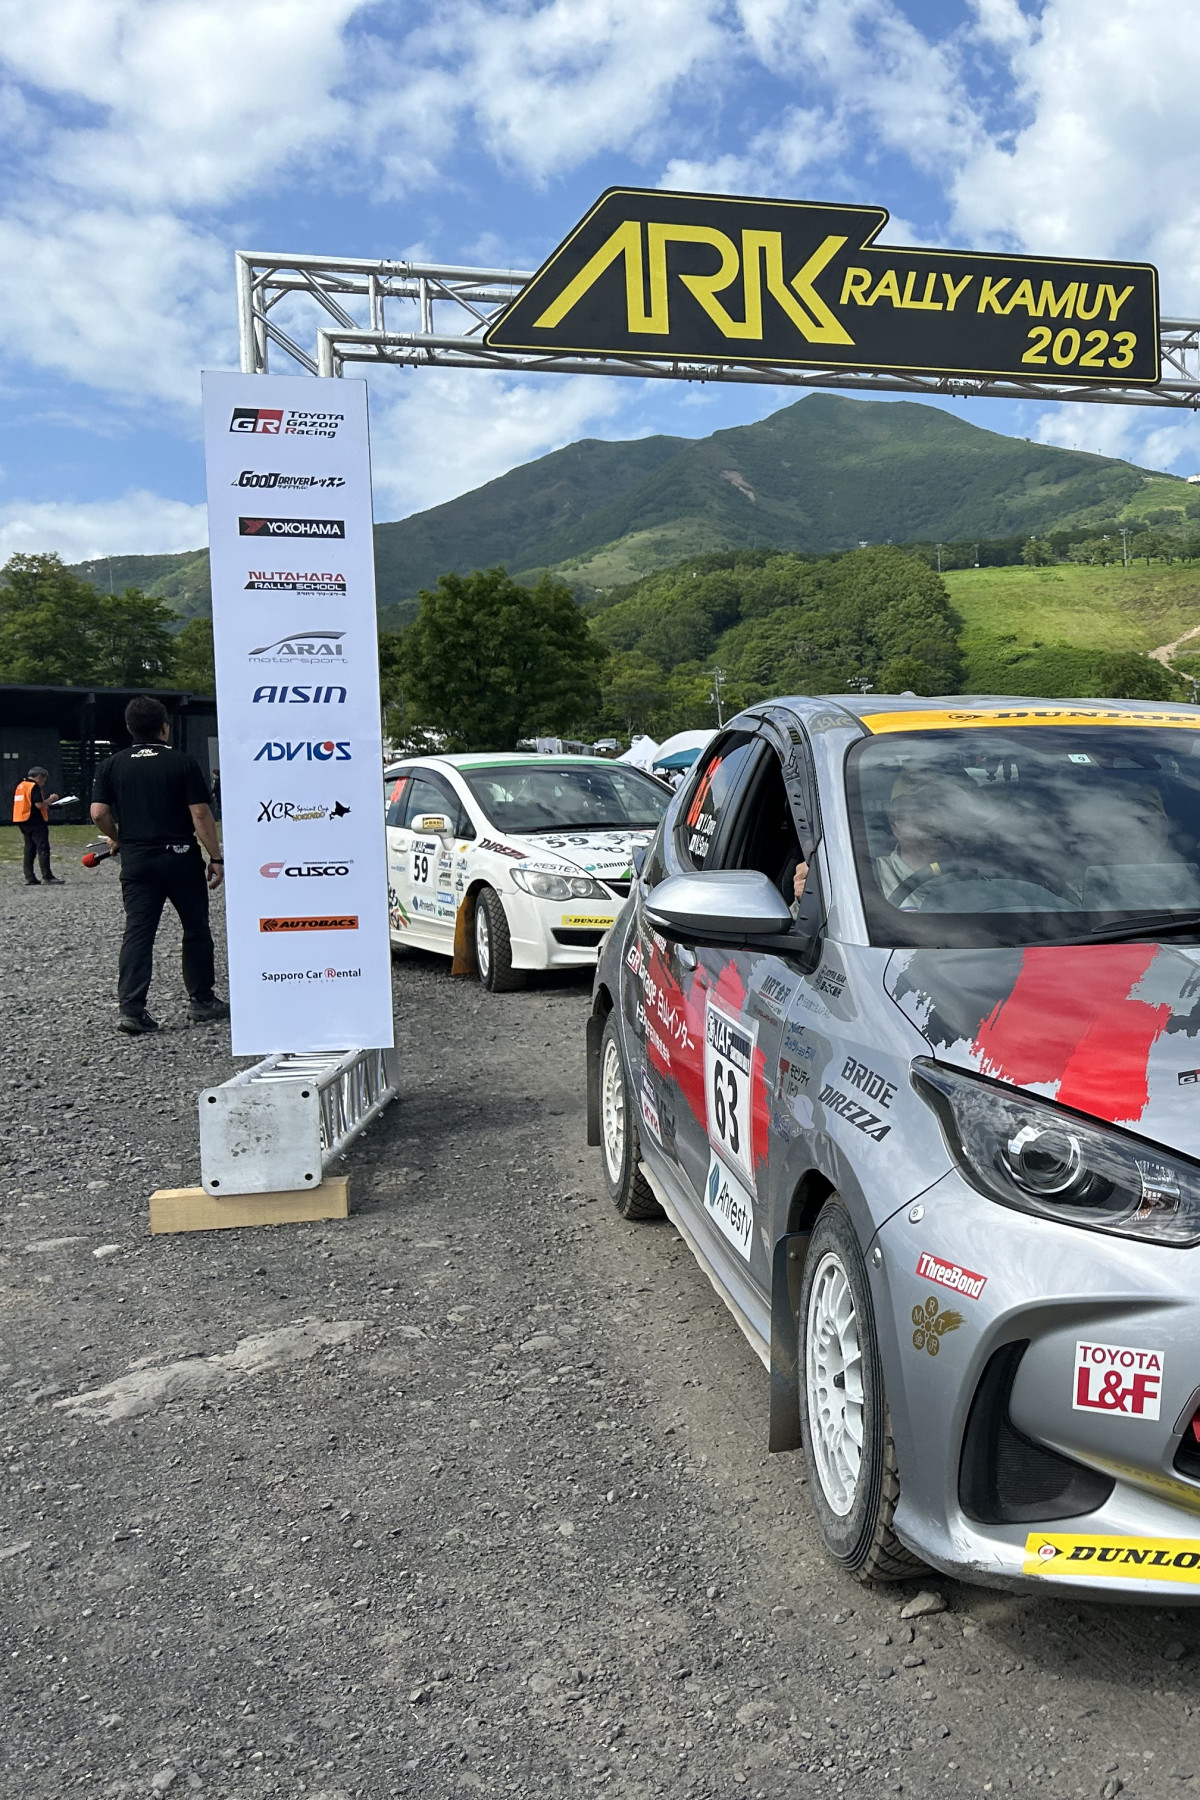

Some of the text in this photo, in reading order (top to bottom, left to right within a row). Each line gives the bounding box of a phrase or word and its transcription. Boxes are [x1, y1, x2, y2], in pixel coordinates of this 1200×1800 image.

[532, 220, 855, 345] ARK
[840, 267, 1134, 322] RALLY KAMUY
[1021, 327, 1136, 368] 2023
[230, 414, 282, 434] GR
[287, 419, 338, 429] GAZOO
[288, 411, 344, 420] TOYOTA
[285, 428, 336, 438] Racing
[267, 521, 340, 535] YOKOHAMA
[248, 571, 345, 582] NUTAHARA
[277, 644, 342, 655] ARAI
[252, 686, 347, 703] AISIN
[993, 711, 1196, 721] DUNLOP
[253, 741, 352, 761] ADVICS
[257, 799, 295, 822] XCR
[546, 837, 589, 848] 59
[285, 866, 349, 877] CUSCO
[414, 855, 428, 882] 59
[279, 919, 356, 928] AUTOBACS
[262, 972, 303, 982] Sapporo
[306, 970, 322, 979] Car
[325, 967, 361, 979] Rental
[840, 1056, 898, 1109] BRIDE
[714, 1059, 740, 1155] 63
[818, 1084, 892, 1142] DIREZZA
[717, 1181, 751, 1246] Ahresty
[920, 1254, 984, 1297] ThreeBond
[1080, 1345, 1160, 1370] TOYOTA
[1077, 1367, 1160, 1414] L&F
